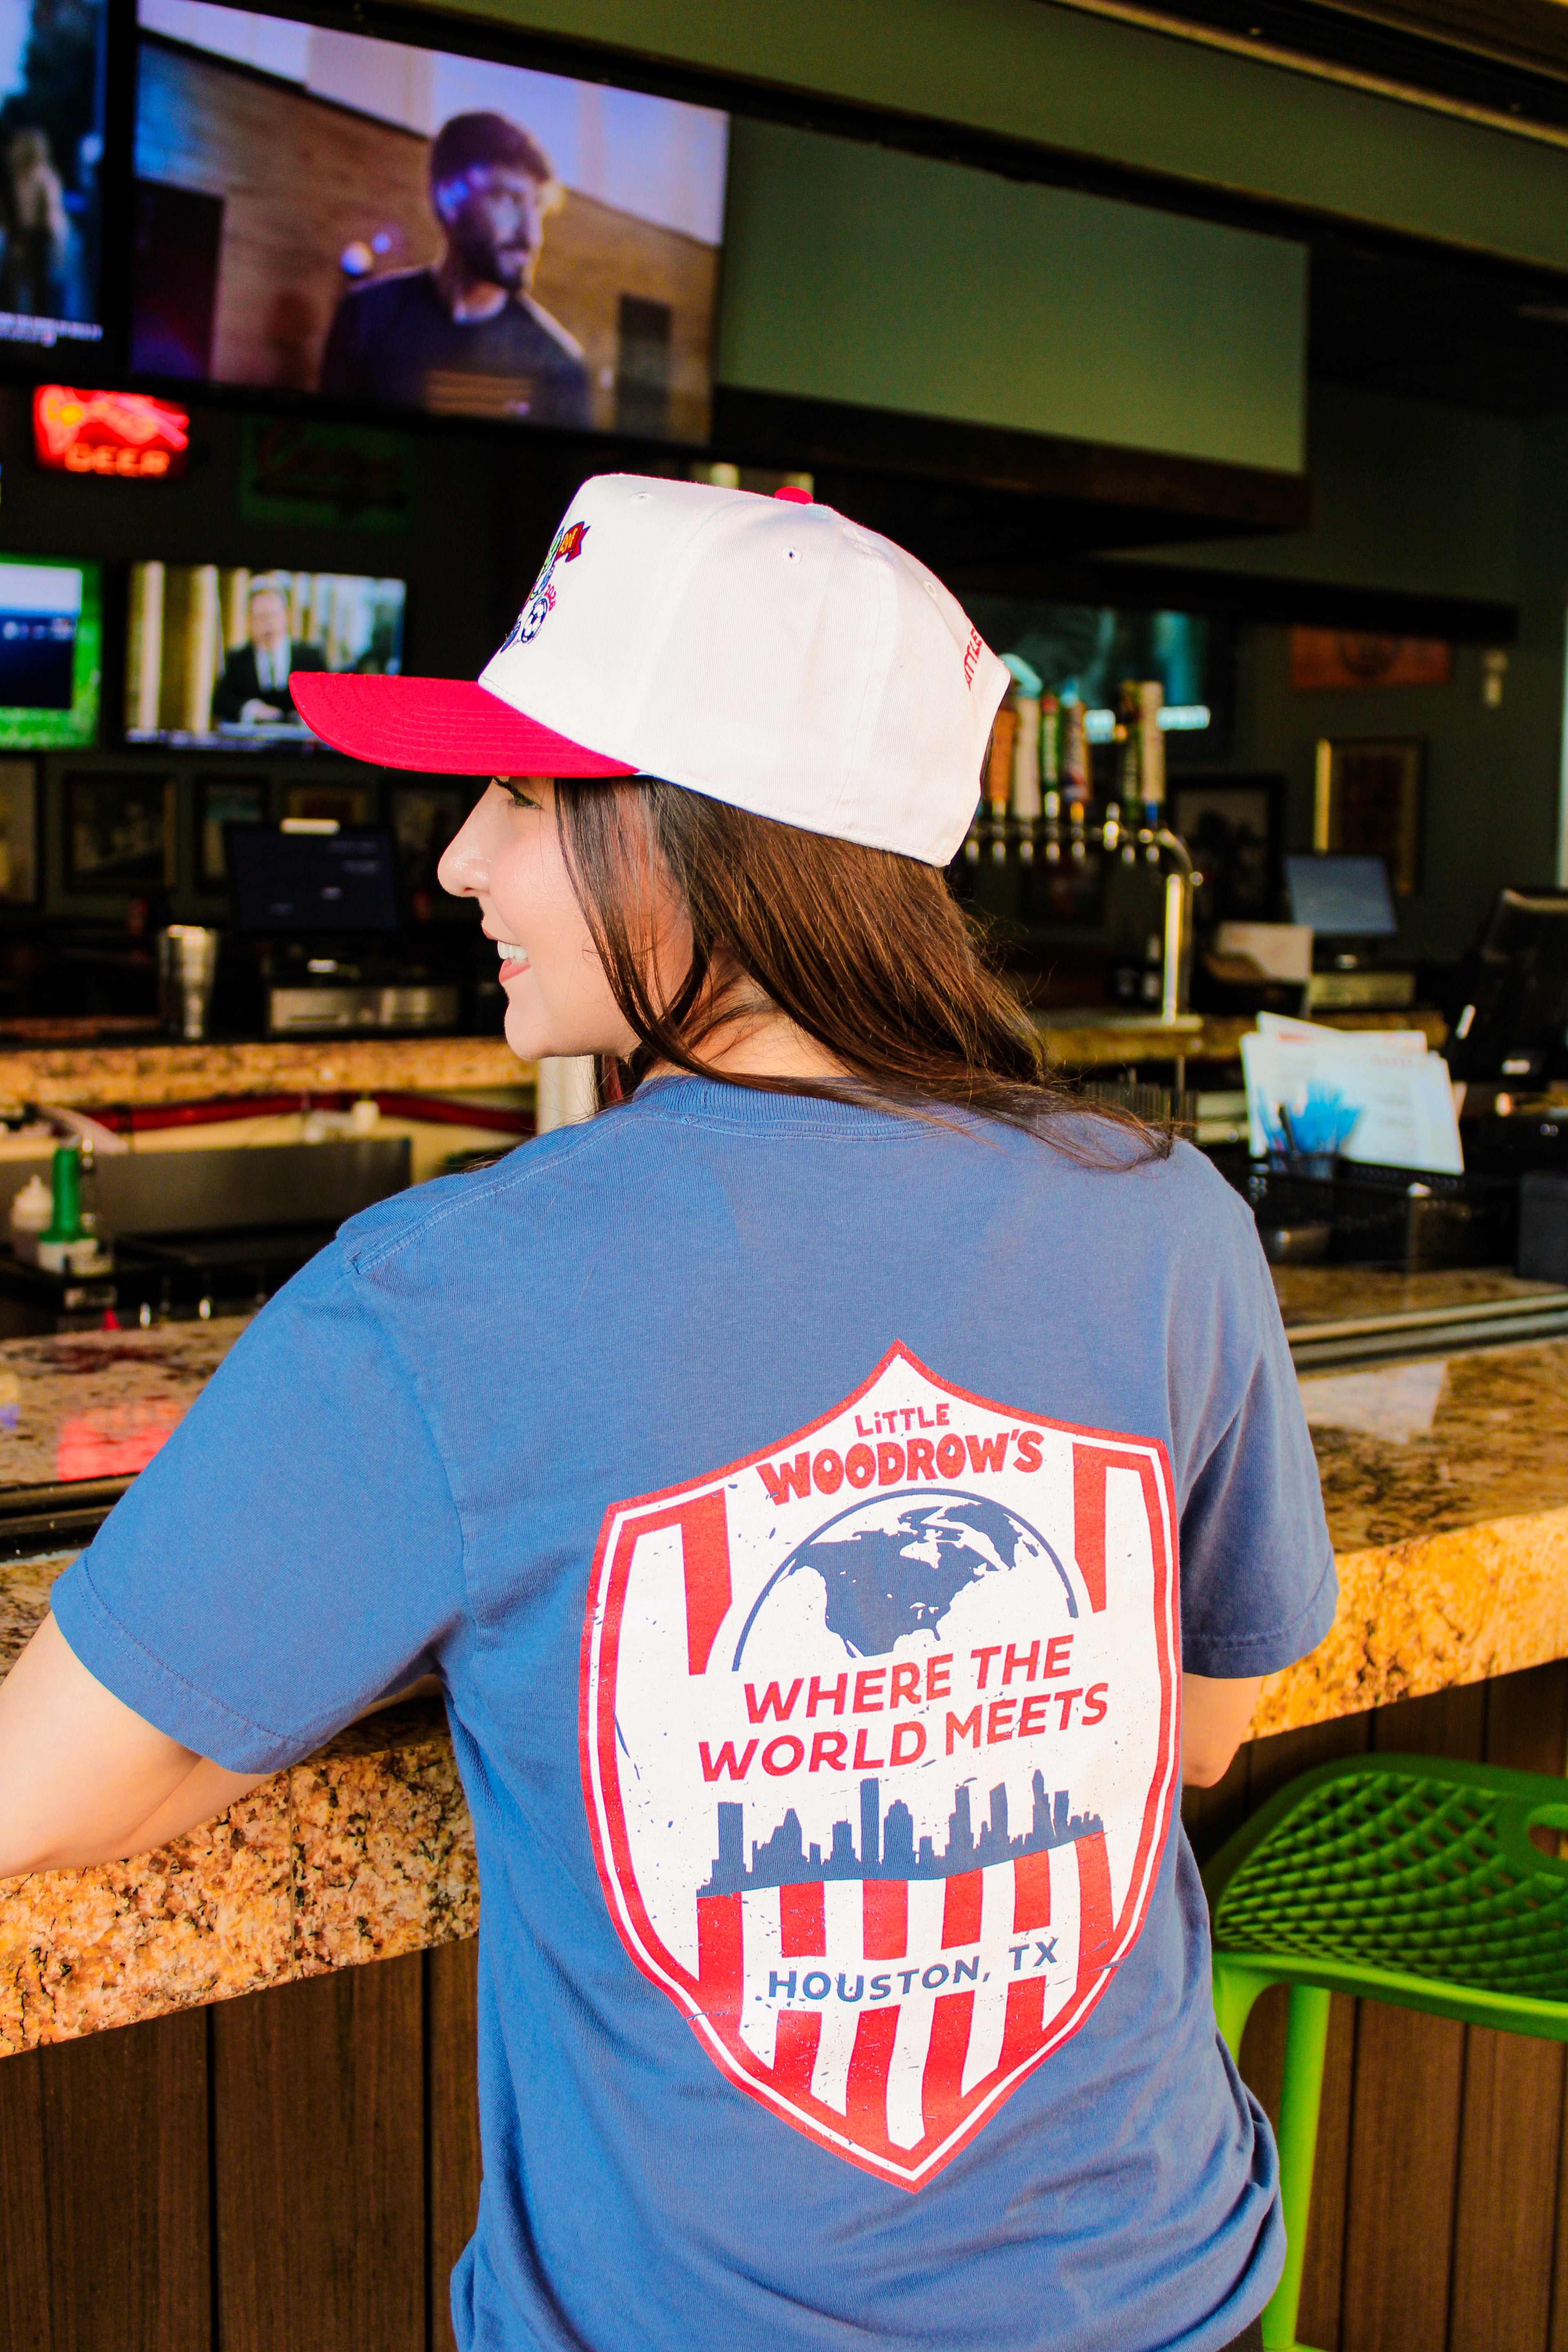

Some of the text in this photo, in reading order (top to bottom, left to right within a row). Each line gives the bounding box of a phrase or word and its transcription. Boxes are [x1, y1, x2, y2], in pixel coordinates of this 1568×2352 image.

[755, 1428, 1045, 1506] WOODROW'S
[744, 1634, 1074, 1724] WHERE THE
[698, 1682, 1109, 1782] WORLD MEETS
[768, 1936, 1058, 2003] HOUSTON, TX
